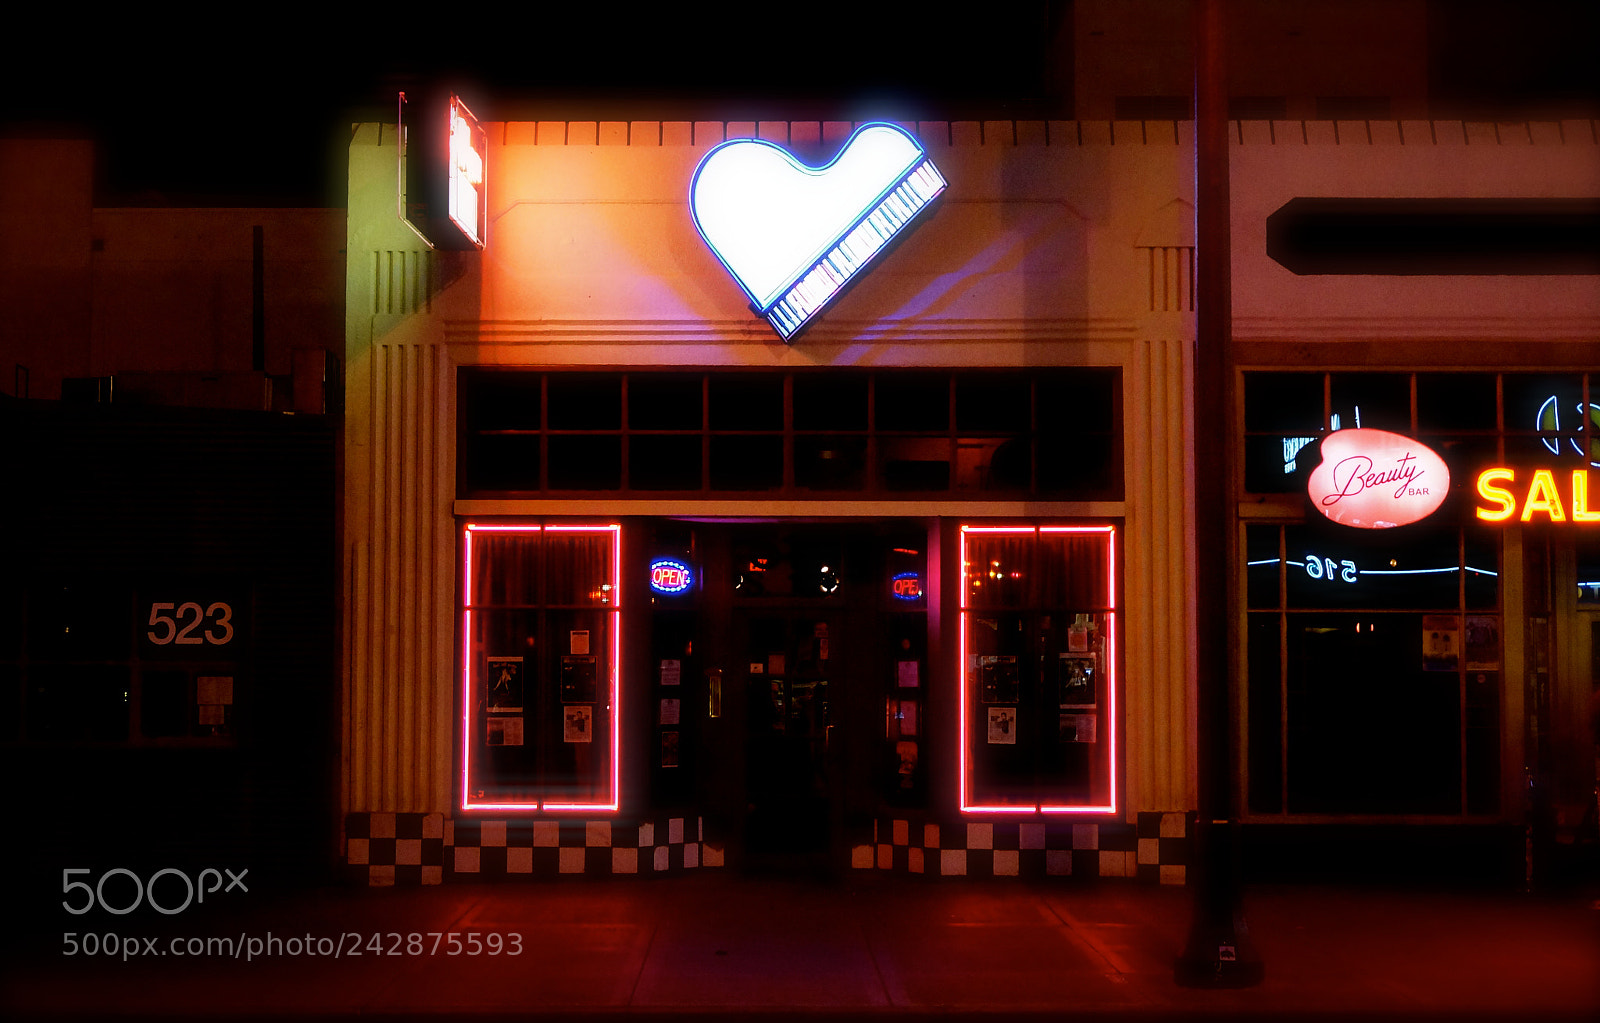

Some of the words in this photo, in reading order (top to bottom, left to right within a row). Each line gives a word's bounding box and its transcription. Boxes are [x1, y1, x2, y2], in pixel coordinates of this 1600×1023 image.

[1322, 452, 1424, 506] Beauty
[1408, 488, 1430, 496] BAR
[653, 568, 686, 586] OPEN
[894, 579, 919, 595] OPE
[147, 602, 234, 645] 523
